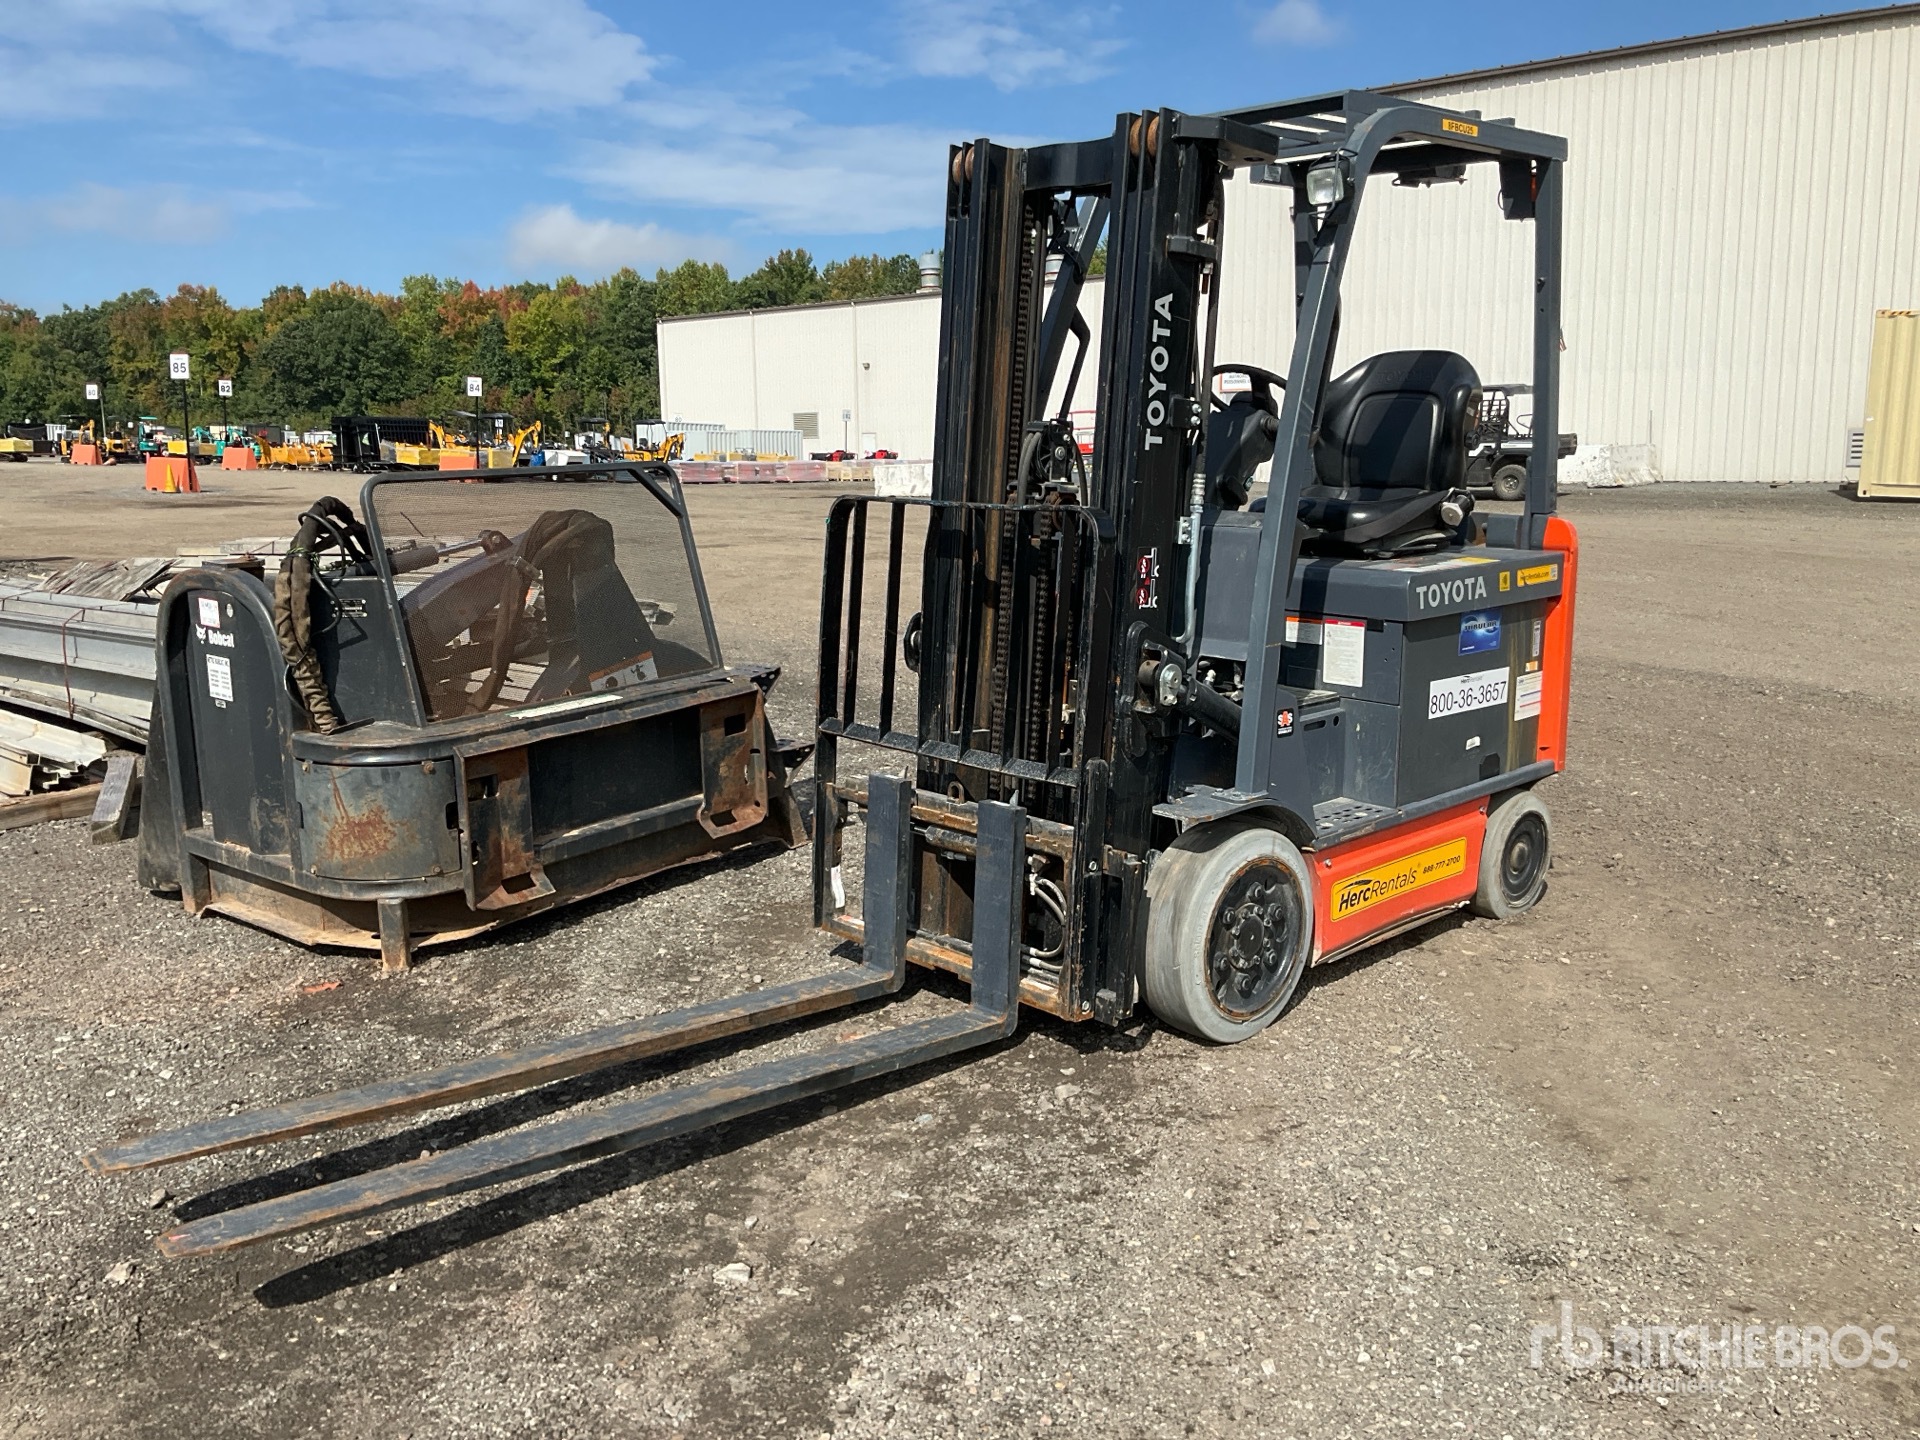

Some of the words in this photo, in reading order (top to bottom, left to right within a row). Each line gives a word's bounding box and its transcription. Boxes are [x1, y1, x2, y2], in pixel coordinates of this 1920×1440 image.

[172, 362, 187, 373] 85
[1144, 293, 1174, 451] TOYOTA
[220, 385, 231, 393] 82
[469, 383, 480, 392] 84
[1416, 576, 1487, 610] TOYOTA
[208, 629, 235, 648] Bobcat
[1429, 681, 1507, 715] 800-36-3657
[1277, 711, 1293, 727] SAS
[1338, 867, 1419, 913] HercRentals
[1422, 855, 1461, 874] 888-777-2700
